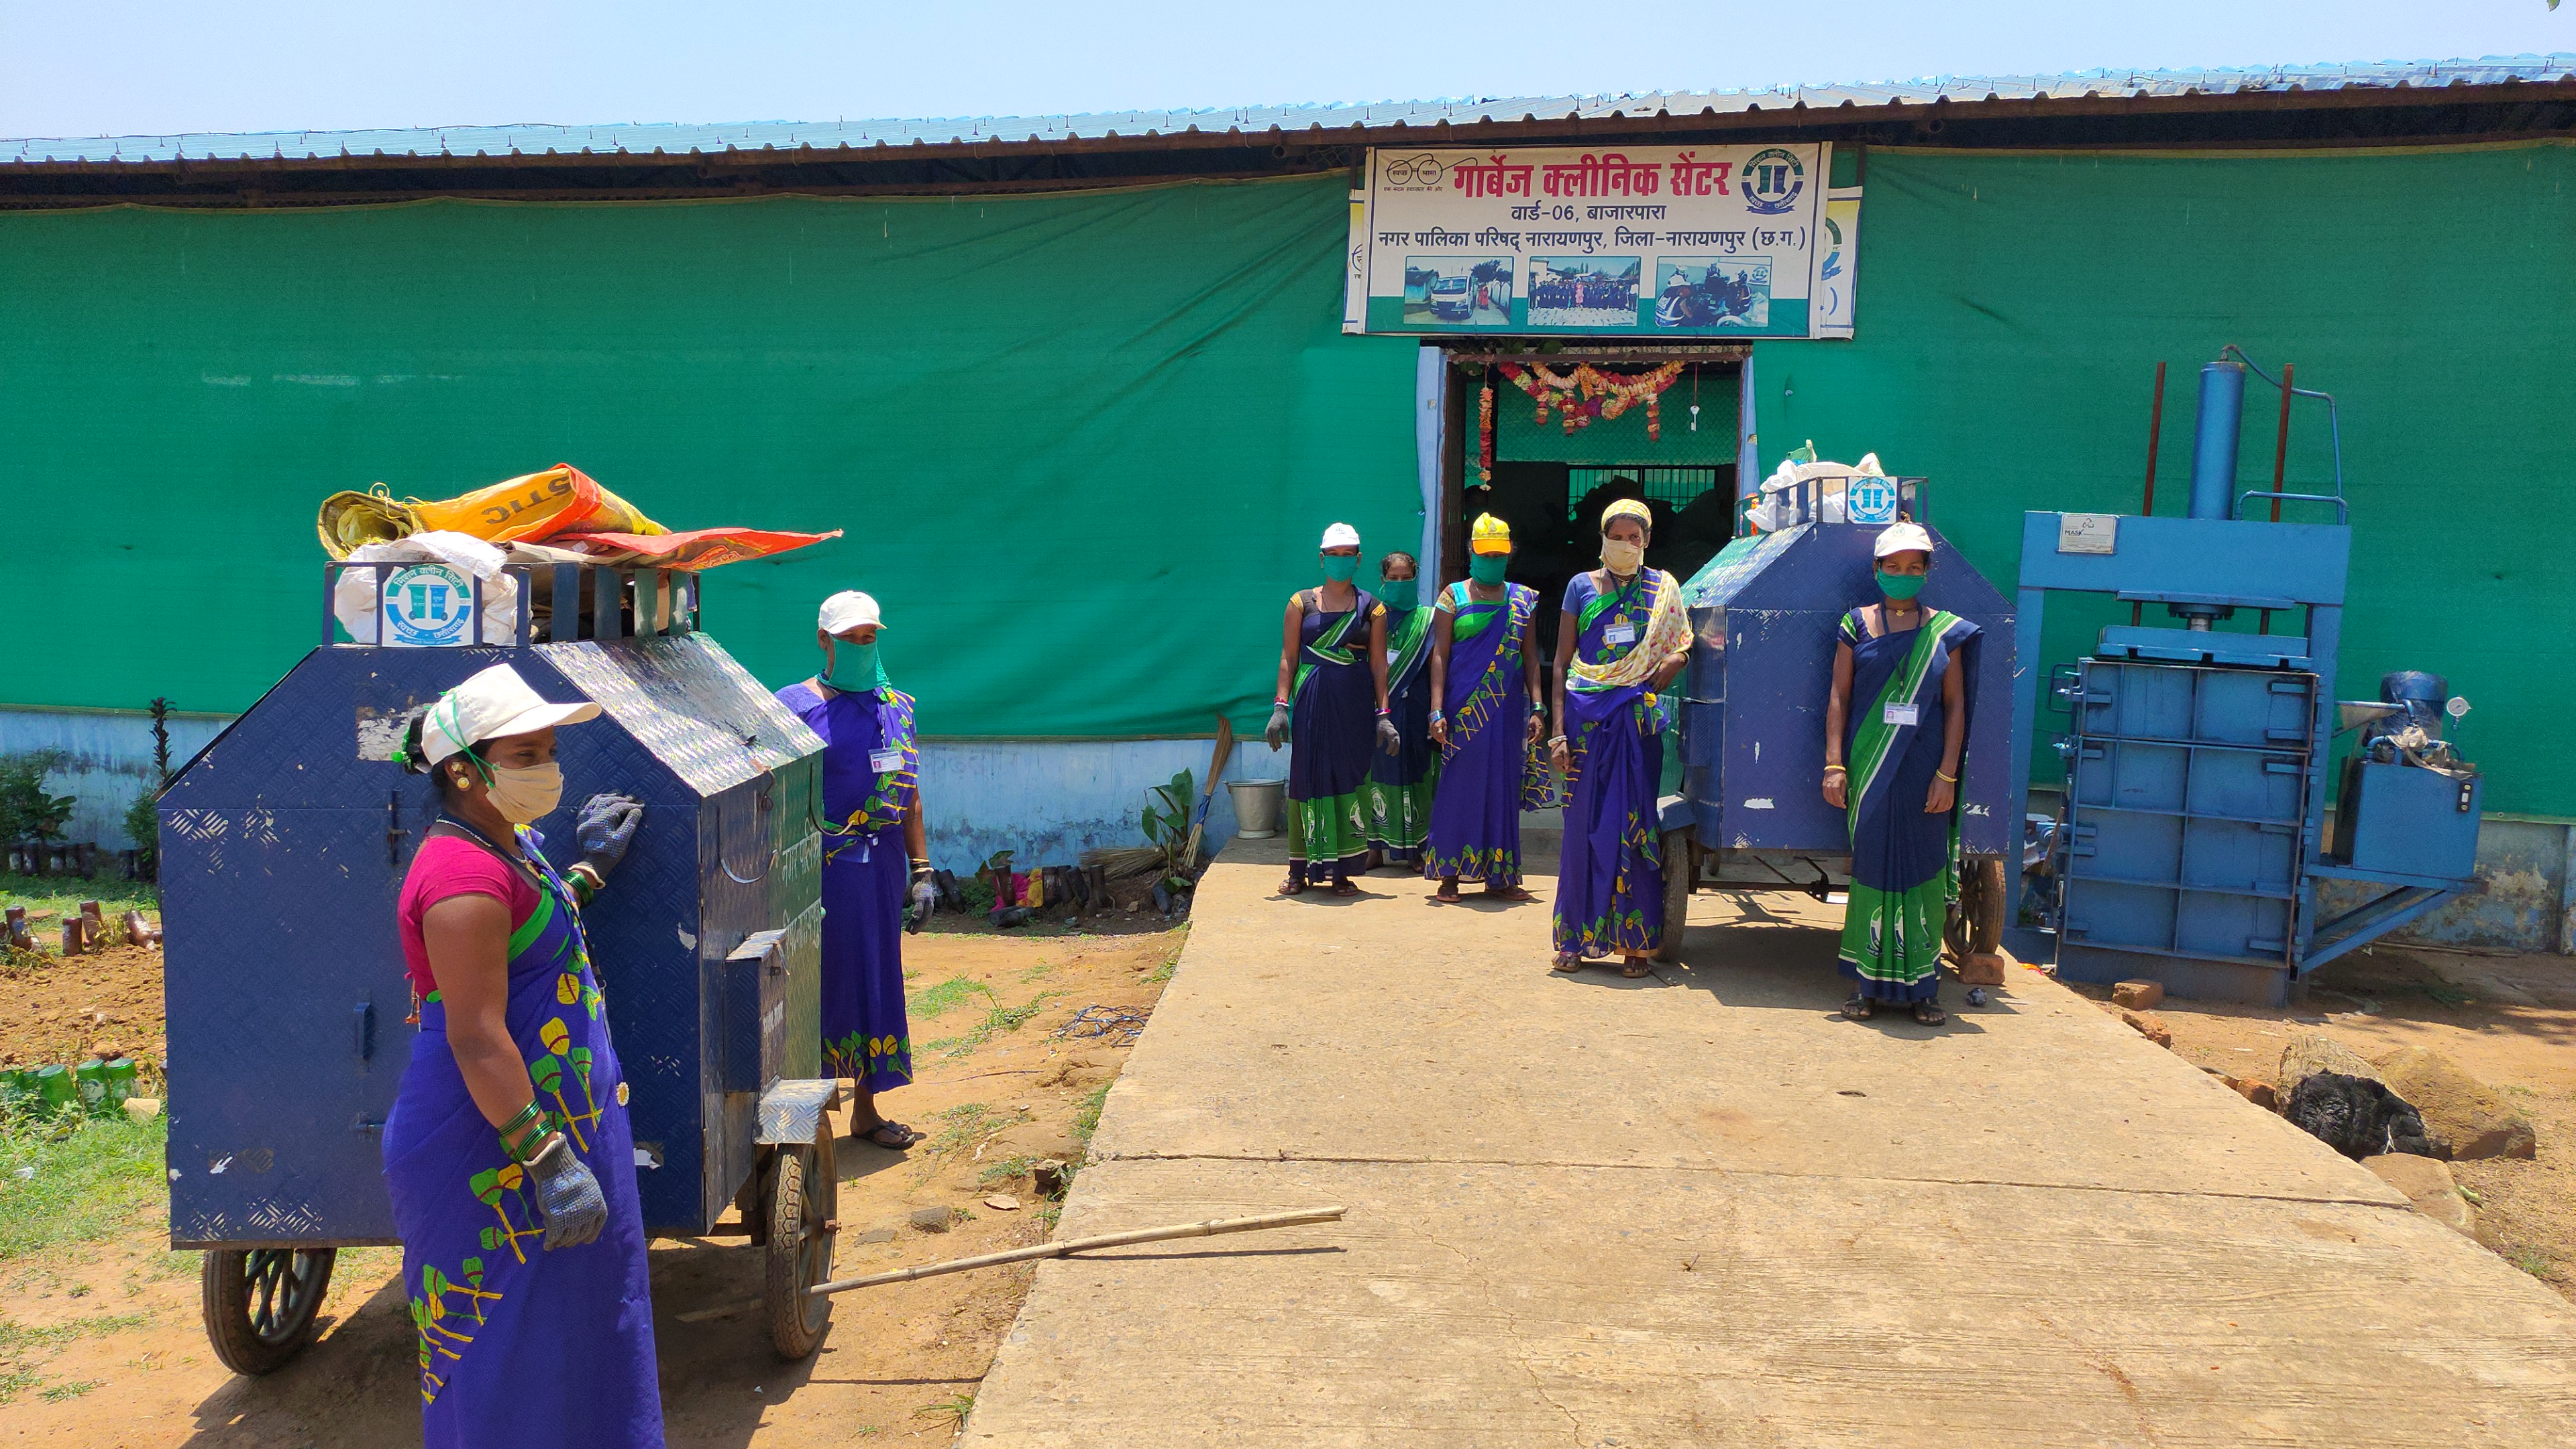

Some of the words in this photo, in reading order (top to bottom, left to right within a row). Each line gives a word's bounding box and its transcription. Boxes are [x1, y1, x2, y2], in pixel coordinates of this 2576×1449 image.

[1454, 154, 1534, 197] गार्बेज
[1542, 153, 1662, 197] क्लीनिक
[1670, 151, 1733, 197] सेंटर
[1511, 199, 1580, 223] वार्ड-06,
[1587, 205, 1668, 221] बाजारपारा
[1378, 231, 1410, 248] नगर
[1414, 226, 1470, 247] पालिका
[1474, 226, 1522, 253] परिषद्
[1525, 231, 1607, 254] नारायणपुर,
[1614, 226, 1747, 254] जिला-नारायणपुर
[1752, 226, 1807, 252] (छ.ग.)
[393, 569, 417, 588] मिशन
[419, 565, 444, 576] क्लीन
[445, 570, 464, 588] सिटी
[396, 620, 420, 637] स्वच्छ
